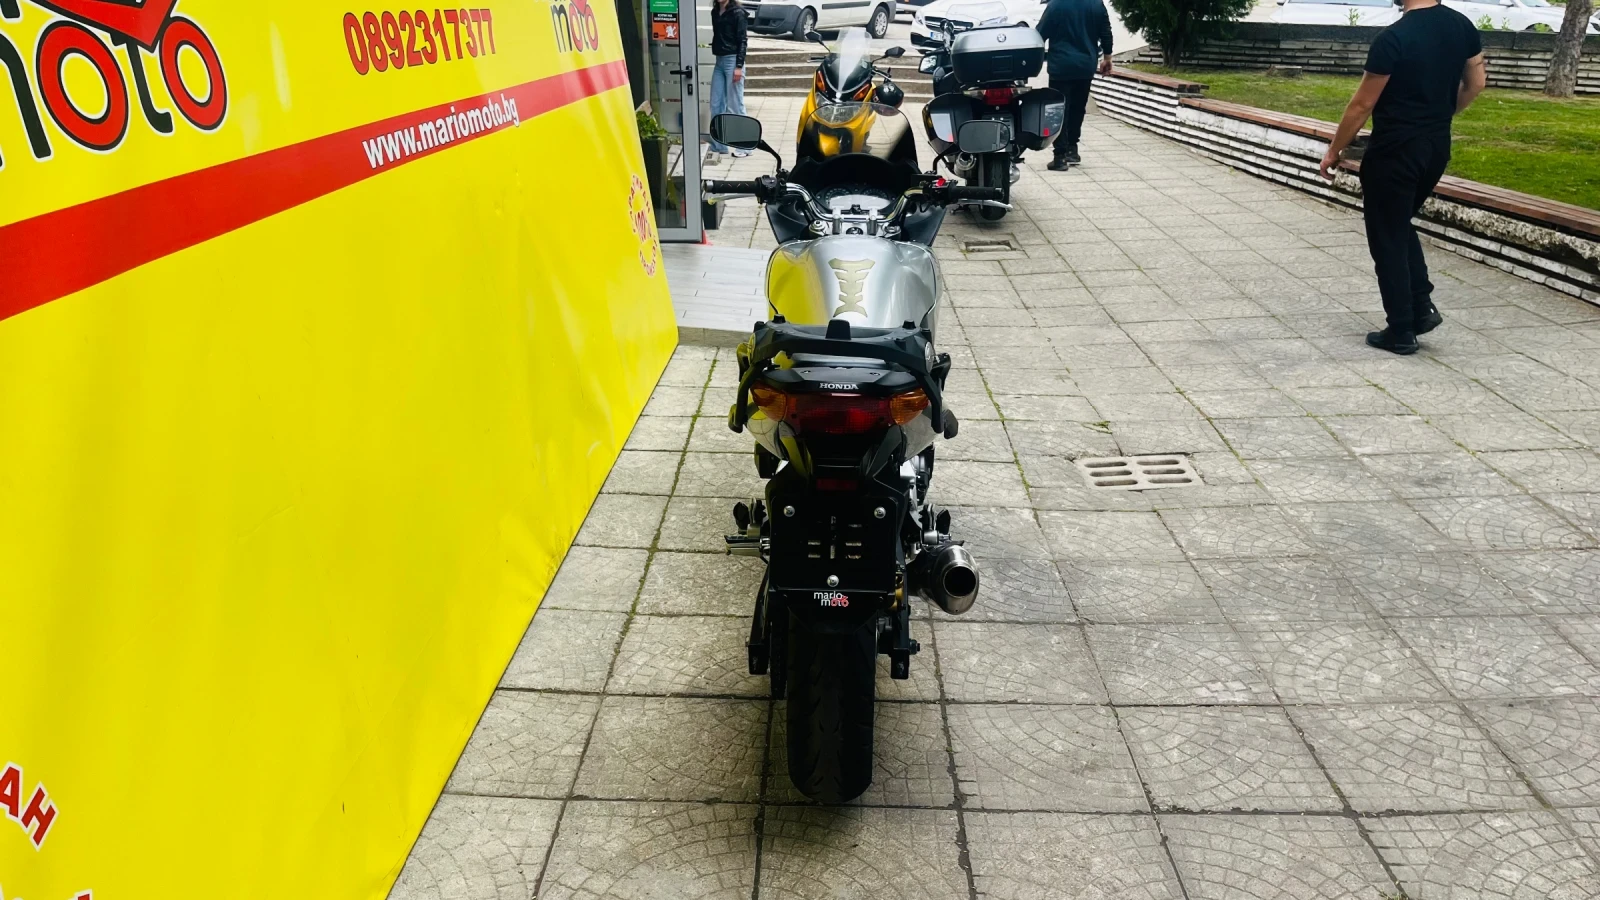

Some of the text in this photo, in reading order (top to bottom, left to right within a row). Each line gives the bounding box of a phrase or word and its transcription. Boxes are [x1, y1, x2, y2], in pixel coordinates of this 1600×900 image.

[343, 8, 496, 76] 0892317377
[550, 3, 599, 53] moto
[362, 93, 520, 169] www.mariomoto.bg
[819, 382, 859, 390] HONDA
[813, 591, 843, 600] mario
[820, 597, 849, 608] moto
